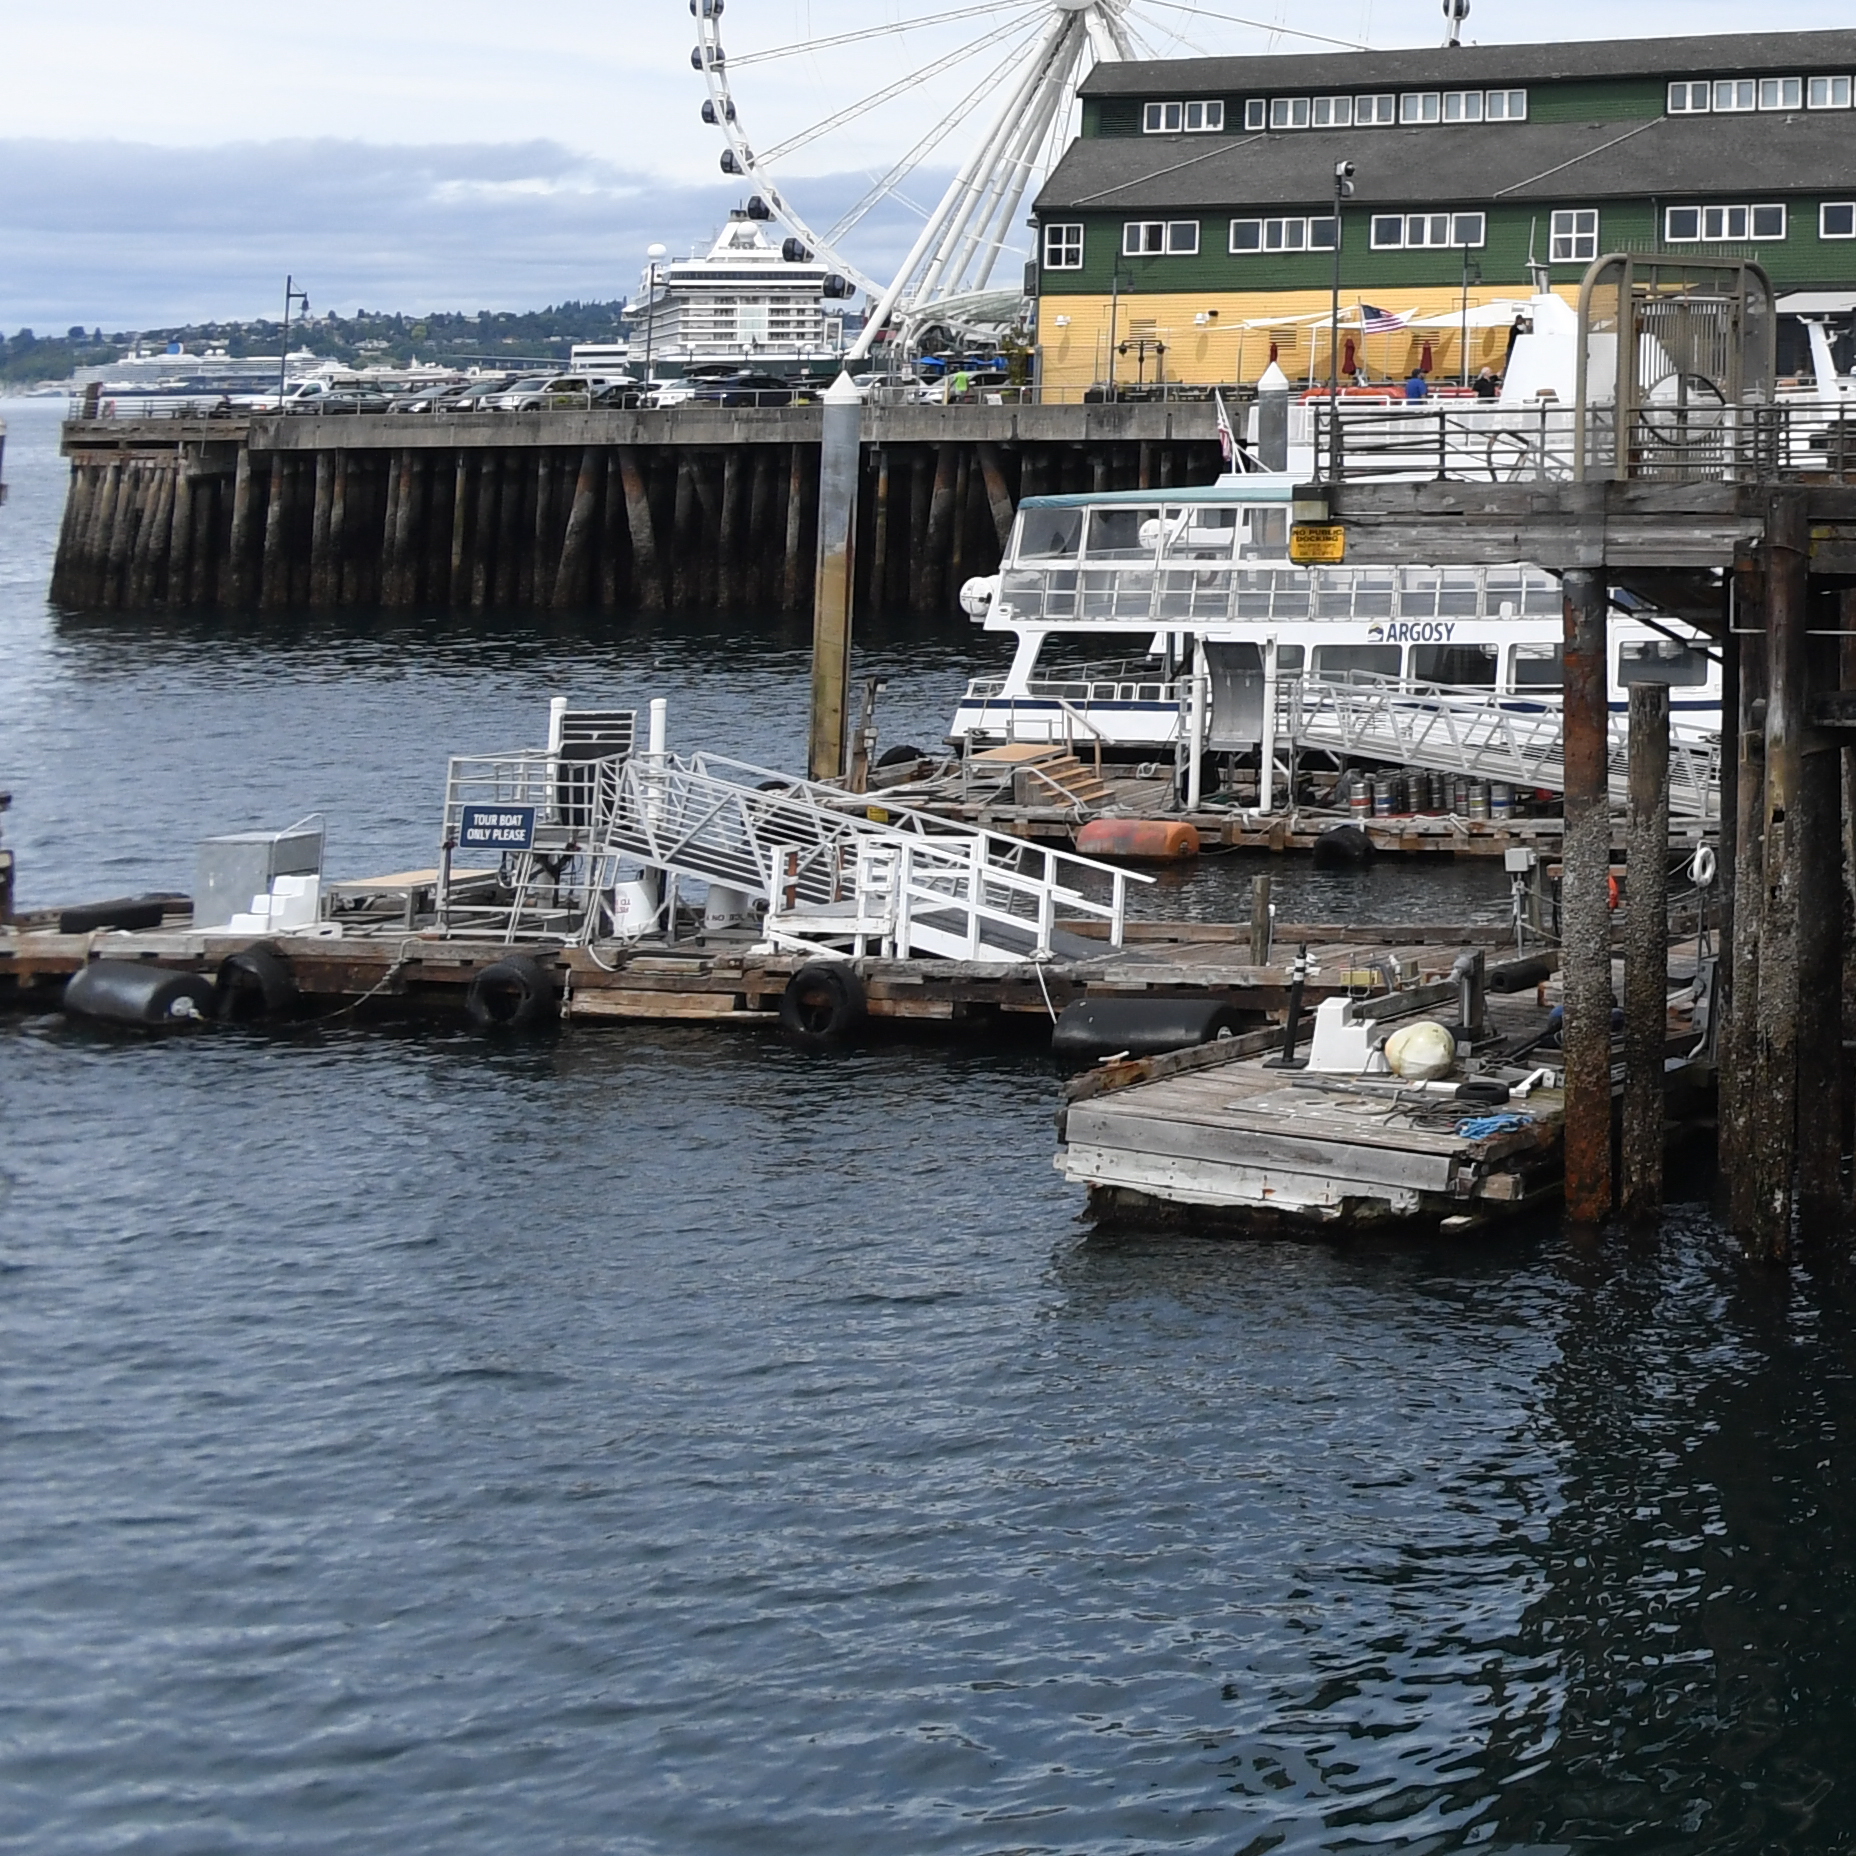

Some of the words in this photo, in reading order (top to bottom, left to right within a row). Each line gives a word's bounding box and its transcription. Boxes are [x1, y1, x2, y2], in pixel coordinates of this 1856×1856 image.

[1386, 622, 1456, 642] ARGOSY
[473, 813, 498, 825] TOUR
[499, 814, 523, 826] BOAT
[467, 828, 491, 840] ONLY
[492, 829, 526, 841] PLEASE
